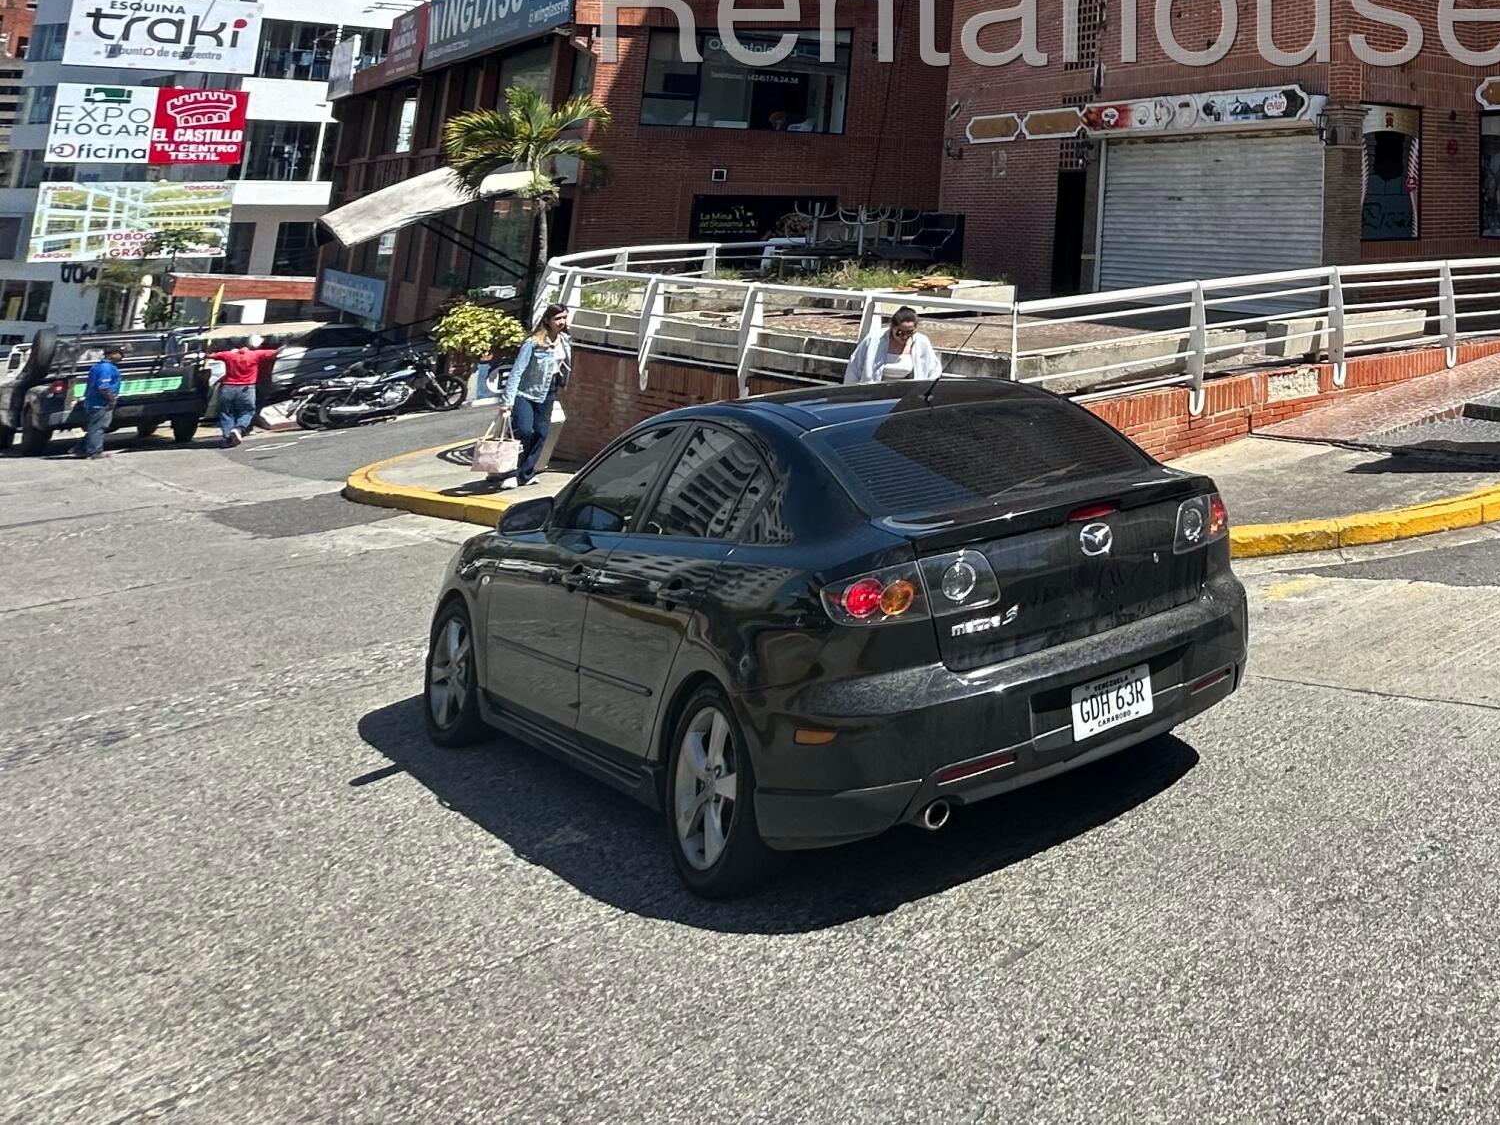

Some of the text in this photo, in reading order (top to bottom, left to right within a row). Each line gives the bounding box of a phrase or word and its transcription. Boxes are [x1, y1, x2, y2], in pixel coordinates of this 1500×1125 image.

[110, 0, 186, 14] ESQUINA
[86, 7, 248, 48] traki
[55, 105, 152, 123] EXPO
[53, 123, 150, 136] HOGAR
[152, 128, 243, 143] EL CASTILLO
[155, 143, 238, 152] TU CENTRO
[168, 151, 220, 161] TEXTIL
[1094, 675, 1129, 692] VENEZUELA
[1080, 678, 1145, 724] GDH 63R
